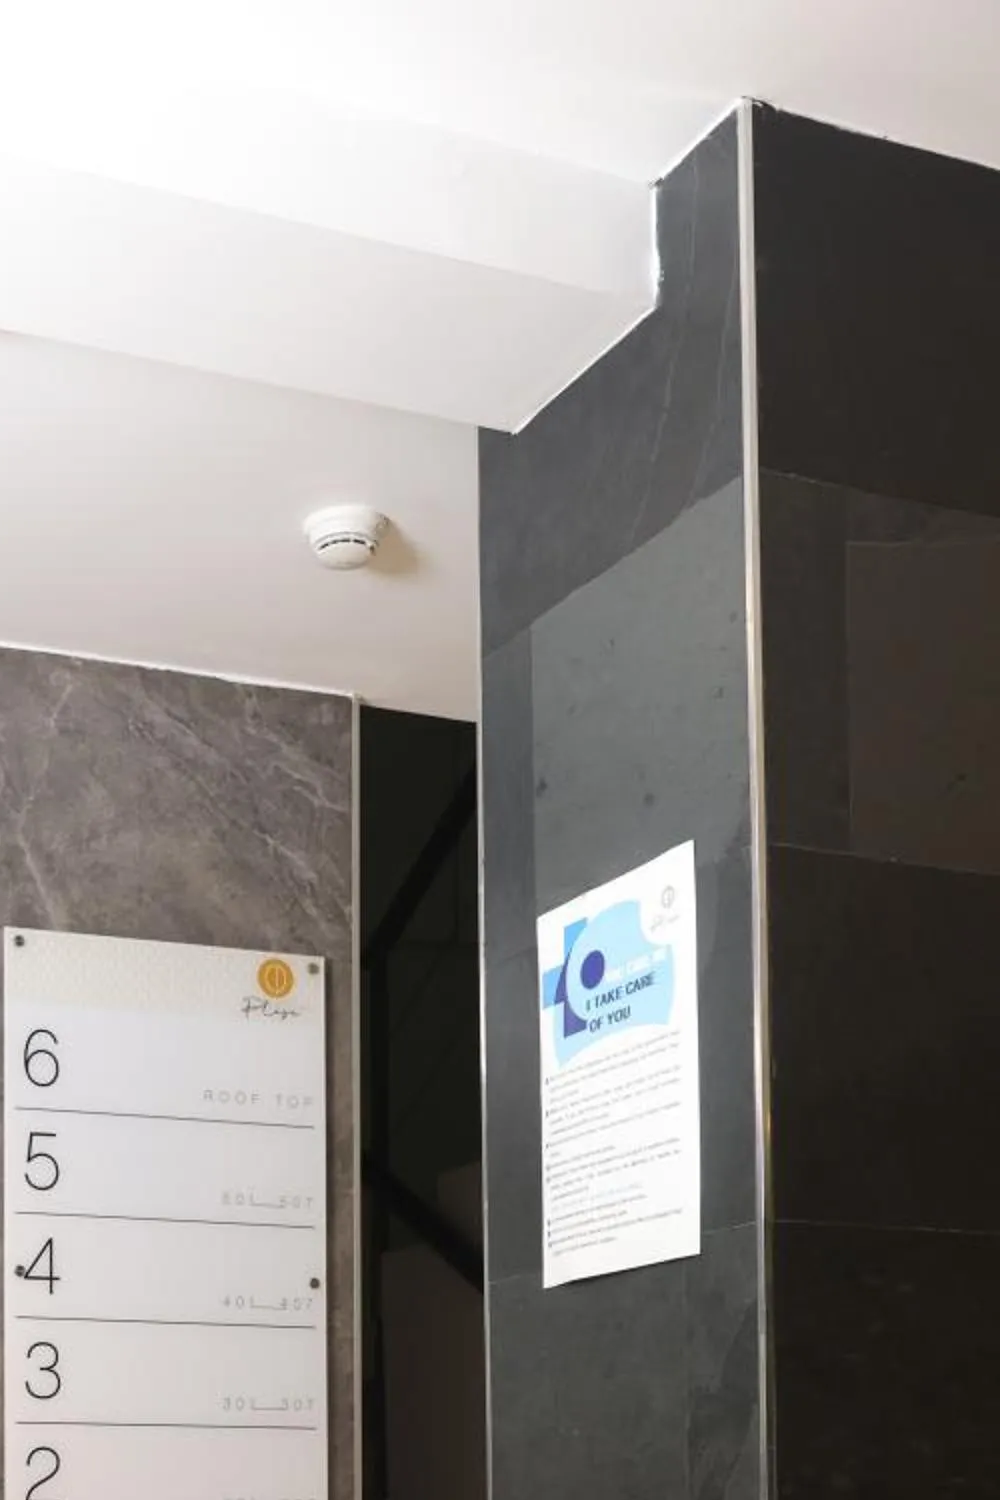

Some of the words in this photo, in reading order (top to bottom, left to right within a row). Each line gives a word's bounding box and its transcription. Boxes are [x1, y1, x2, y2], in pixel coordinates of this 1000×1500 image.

[589, 1018, 604, 1032] OF
[607, 1006, 631, 1024] YOU
[595, 984, 623, 1010] TAKE
[625, 971, 655, 995] CARE
[24, 1029, 60, 1088] 6
[203, 1090, 261, 1106] ROOF
[25, 1132, 60, 1191] 5
[24, 1237, 61, 1294] 4
[25, 1342, 61, 1400] 3
